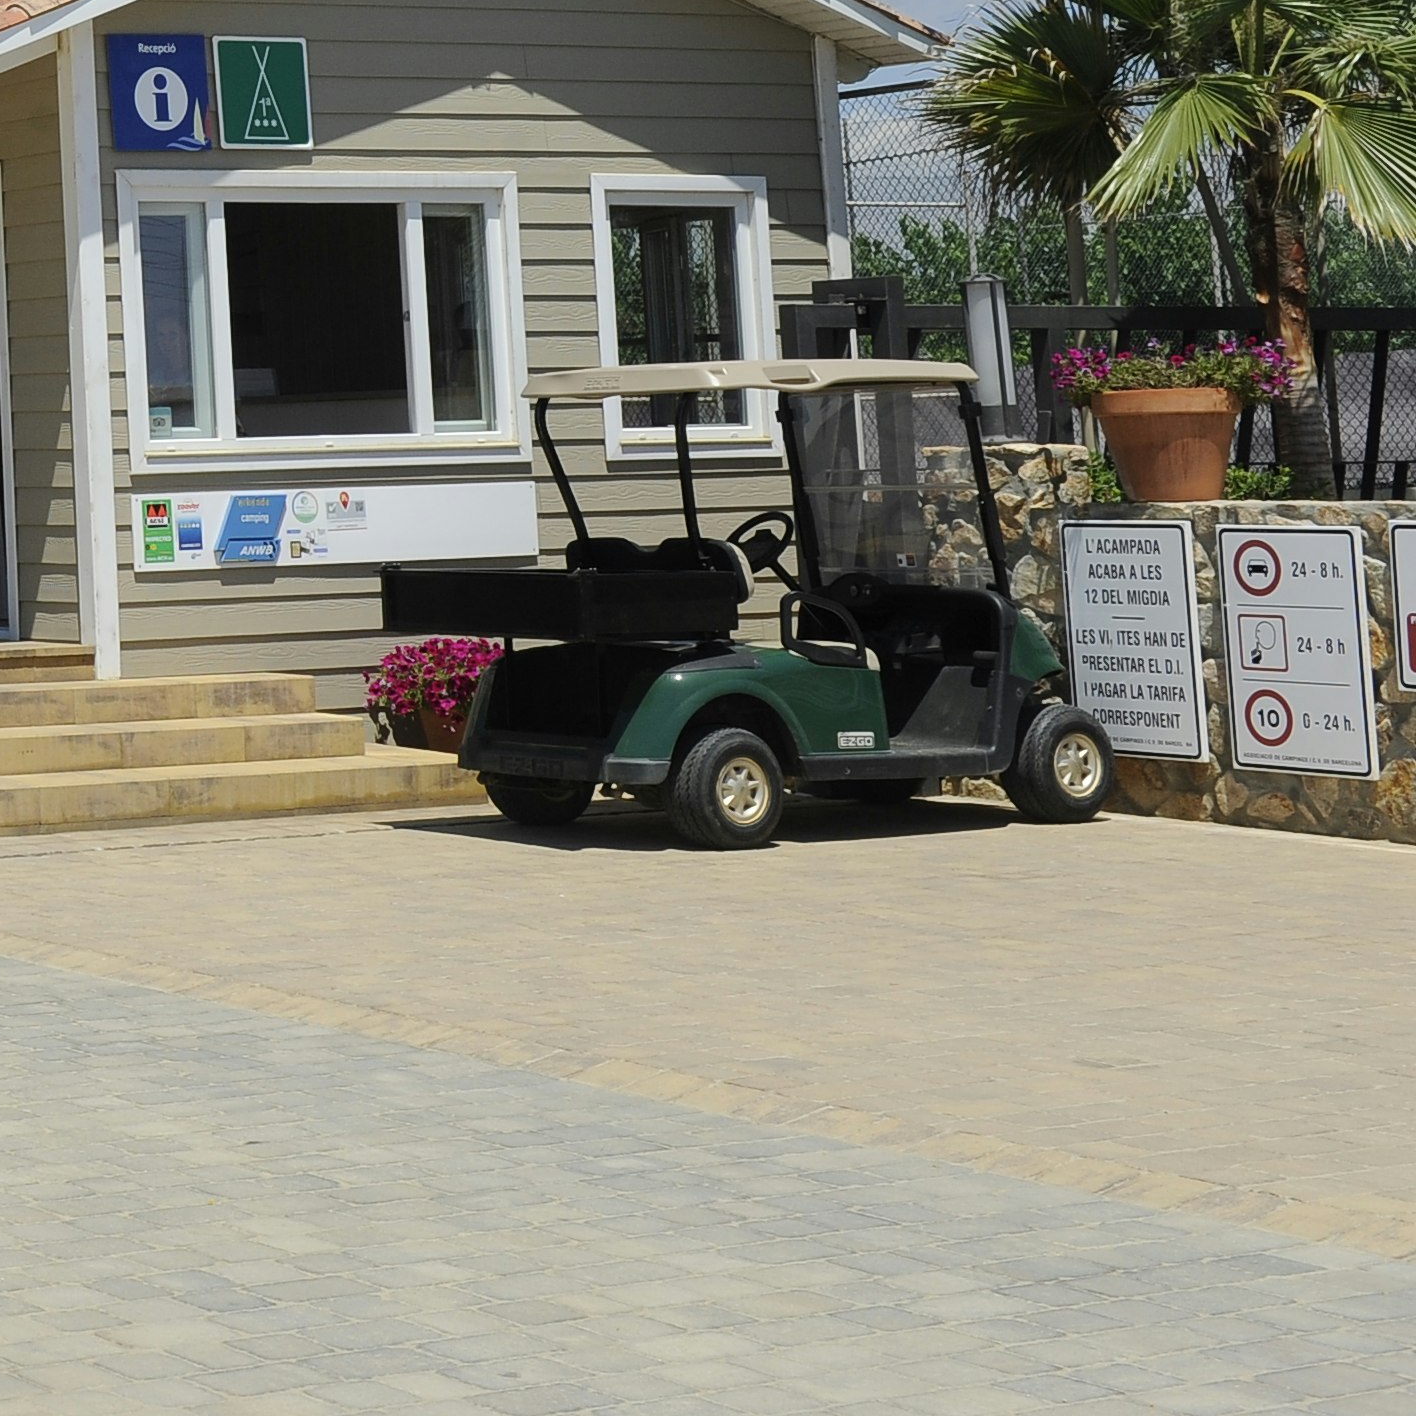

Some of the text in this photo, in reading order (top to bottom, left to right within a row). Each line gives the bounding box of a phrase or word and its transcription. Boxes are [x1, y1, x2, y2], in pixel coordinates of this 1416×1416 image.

[138, 43, 177, 56] Recepció
[241, 512, 270, 524] camping
[240, 545, 274, 556] ANWB
[1085, 538, 1161, 555] L'ACAMPADA
[1088, 564, 1162, 580] ACABA A LES
[1291, 561, 1307, 577] 24
[1320, 562, 1328, 578] 8
[1084, 589, 1170, 606] 12 DEL MIGDIA
[1076, 629, 1096, 645] LES
[1144, 631, 1168, 647] HAN
[1171, 632, 1186, 648] DE
[1296, 636, 1312, 653] 24
[1326, 638, 1334, 654] 8
[1337, 638, 1345, 655] h
[1082, 655, 1184, 675] PRESENTAR EL D.I.
[1084, 681, 1186, 702] I PAGAR LA TARIFA
[1093, 708, 1181, 729] CORRESPONENT
[1257, 708, 1280, 727] 10
[1324, 714, 1339, 731] 24
